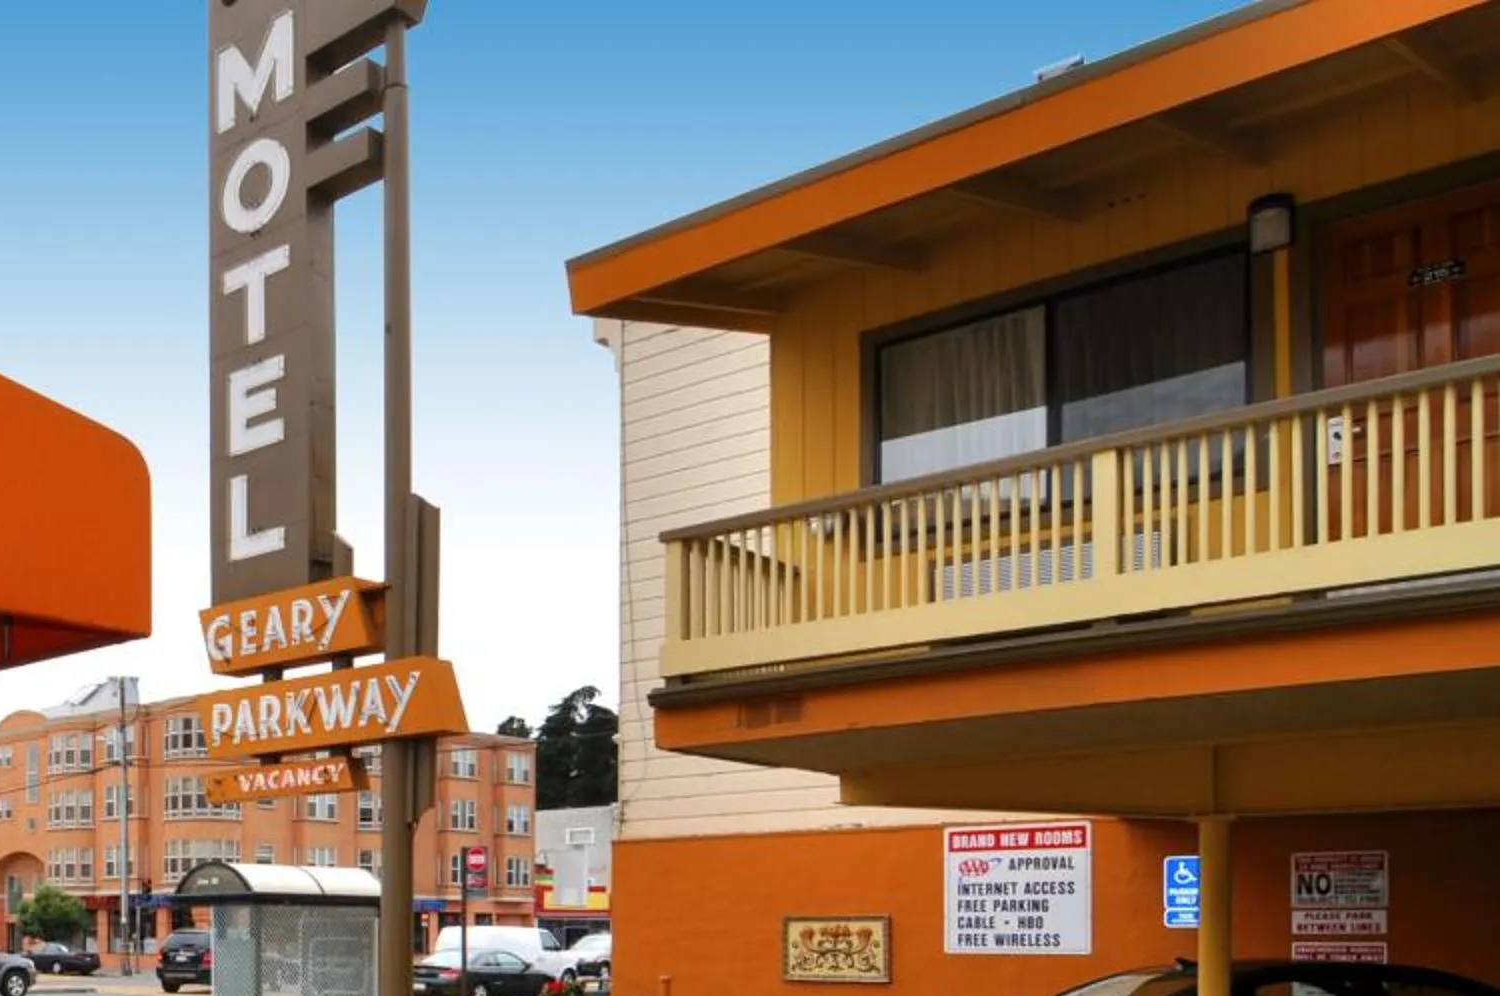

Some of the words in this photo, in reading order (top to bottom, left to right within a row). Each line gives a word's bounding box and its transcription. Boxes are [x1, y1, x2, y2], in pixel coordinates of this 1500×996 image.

[213, 9, 294, 562] MOTEL
[207, 590, 350, 661] GEARY
[211, 671, 420, 747] PARKWAY
[238, 763, 345, 792] VACANCY
[952, 834, 995, 849] BRAND
[1000, 832, 1029, 846] NEW
[1034, 829, 1084, 845] ROOMS
[1008, 856, 1075, 870] APPROVAL
[957, 881, 1018, 896] INTERNET
[1023, 881, 1075, 895] ACCESS
[1298, 874, 1331, 895] NO
[957, 899, 987, 912] FREE
[993, 899, 1049, 912] PARKING
[957, 916, 995, 929] CABLE
[1017, 916, 1044, 929] HBO
[1304, 912, 1340, 920] PLEASE
[1297, 923, 1347, 932] BETWEEN
[957, 933, 988, 947] FREE
[994, 933, 1061, 947] WIRELESS
